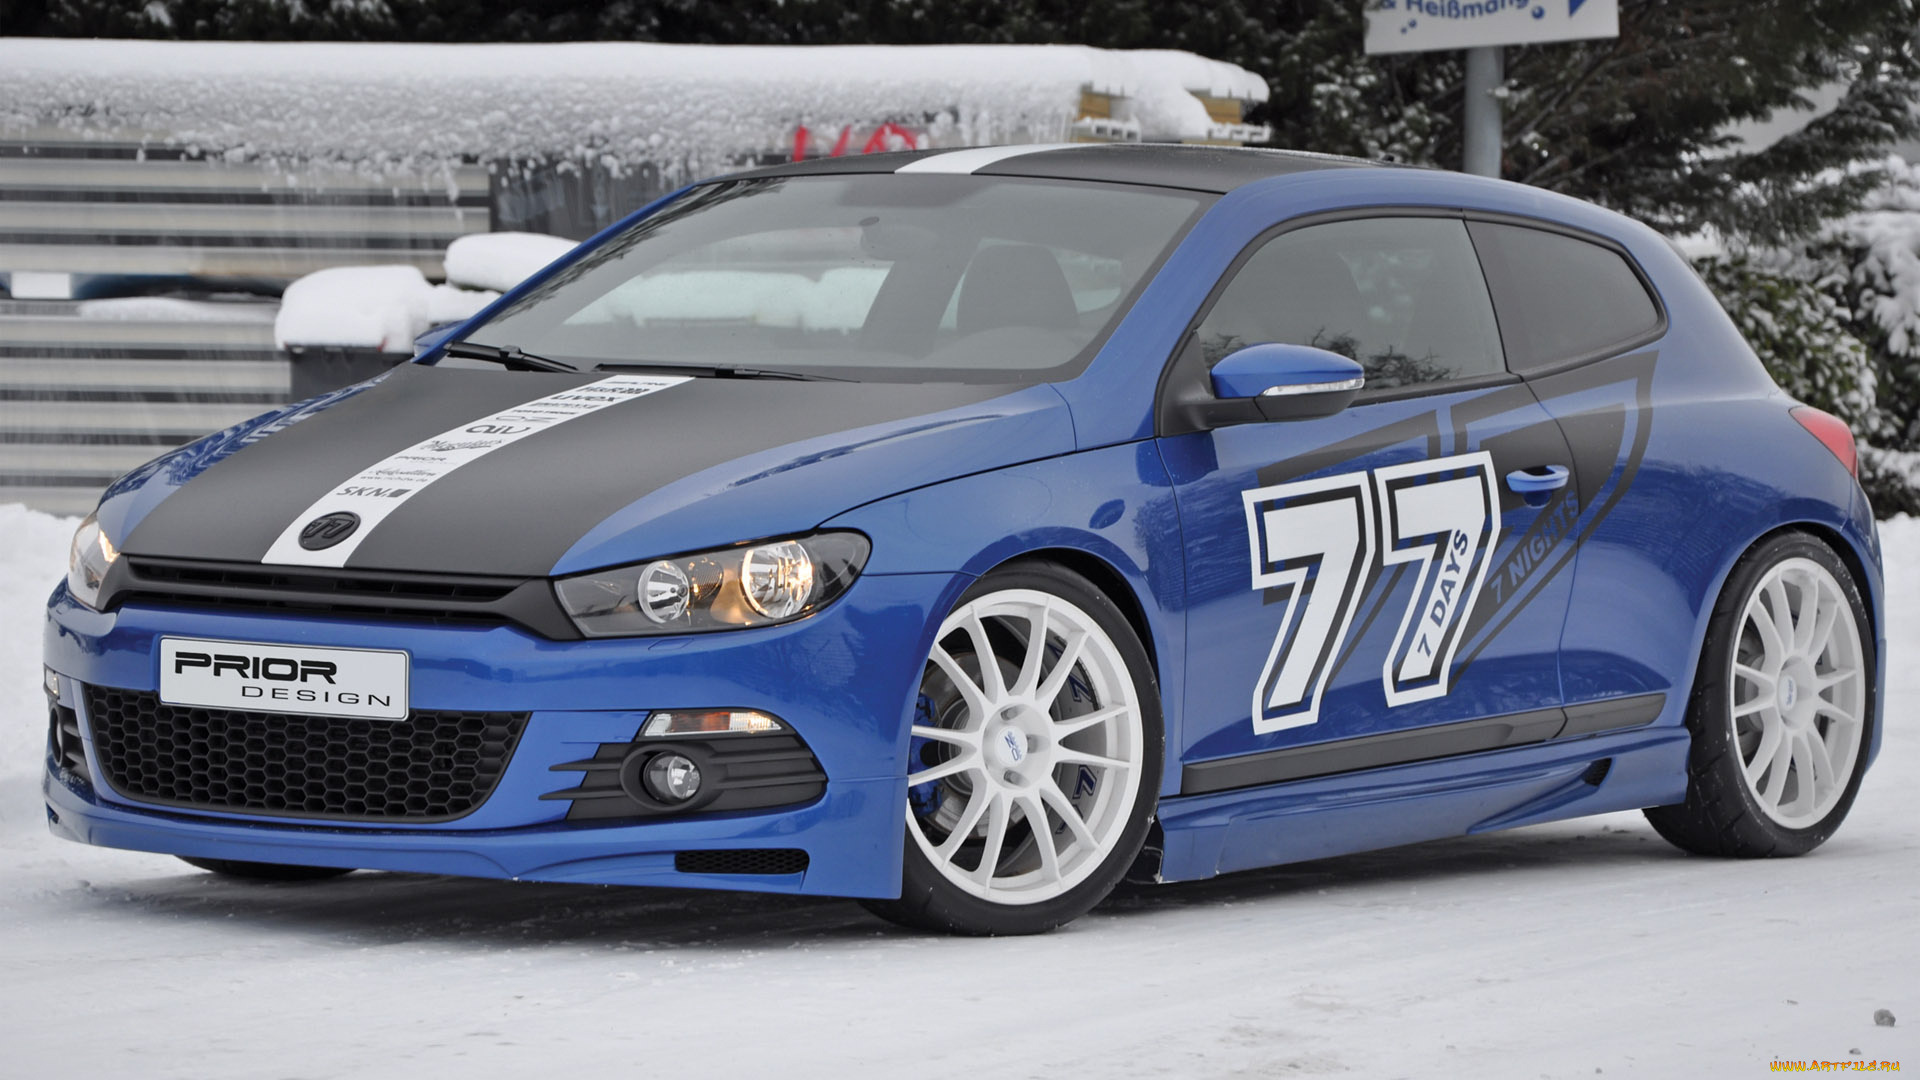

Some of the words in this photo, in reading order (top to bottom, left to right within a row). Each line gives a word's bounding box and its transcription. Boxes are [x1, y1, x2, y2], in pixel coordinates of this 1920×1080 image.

[1241, 450, 1501, 735] 77
[1417, 633, 1432, 657] 7
[1430, 529, 1468, 628] DAYS
[1490, 574, 1503, 604] 7
[1508, 490, 1579, 586] NIGHTS
[175, 651, 337, 684] PRIOR
[241, 686, 391, 707] DESIGN
